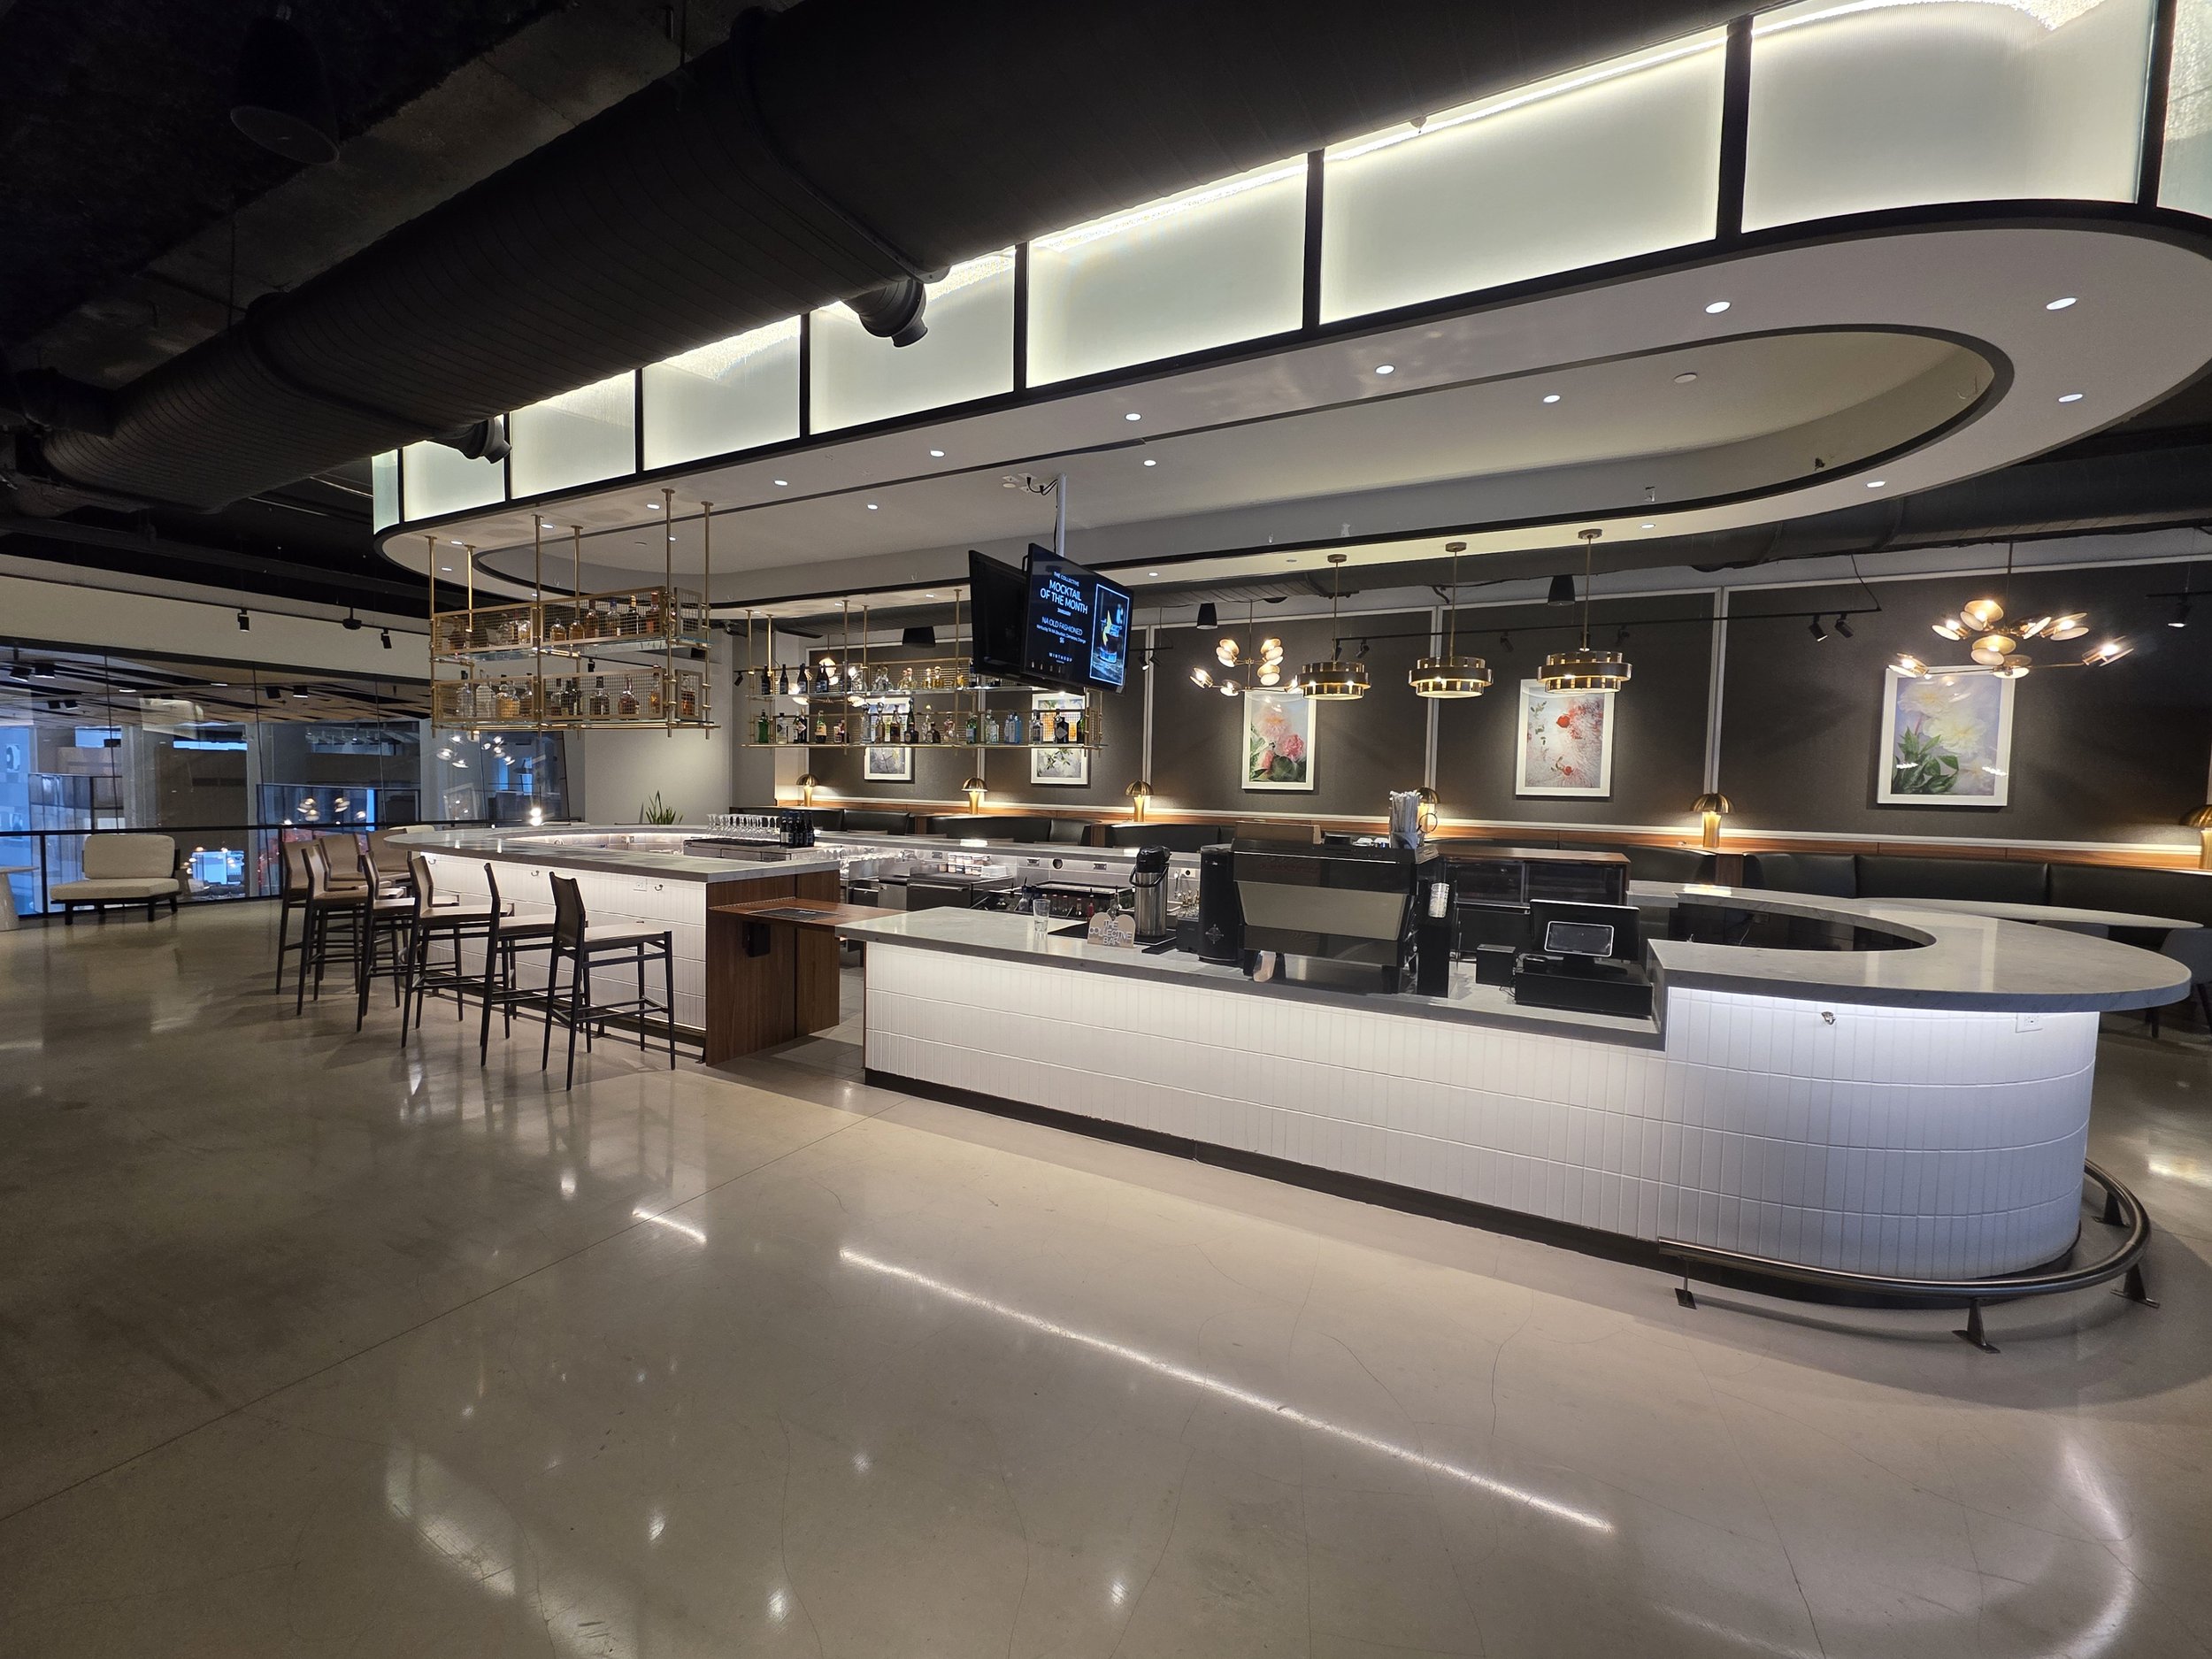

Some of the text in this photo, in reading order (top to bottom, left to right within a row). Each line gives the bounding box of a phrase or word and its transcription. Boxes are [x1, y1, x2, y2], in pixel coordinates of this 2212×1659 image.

[1048, 579, 1082, 602] MOCKTAIL
[1040, 588, 1051, 599] OF
[1051, 591, 1064, 606] THE
[1064, 597, 1088, 615] MONTH
[1041, 616, 1049, 625] NA
[1048, 618, 1059, 628] OLD
[1058, 621, 1084, 636] FASHIONED
[1103, 919, 1118, 929] THE
[1088, 926, 1133, 940] COLLECTIVE
[1103, 936, 1121, 946] BAR
